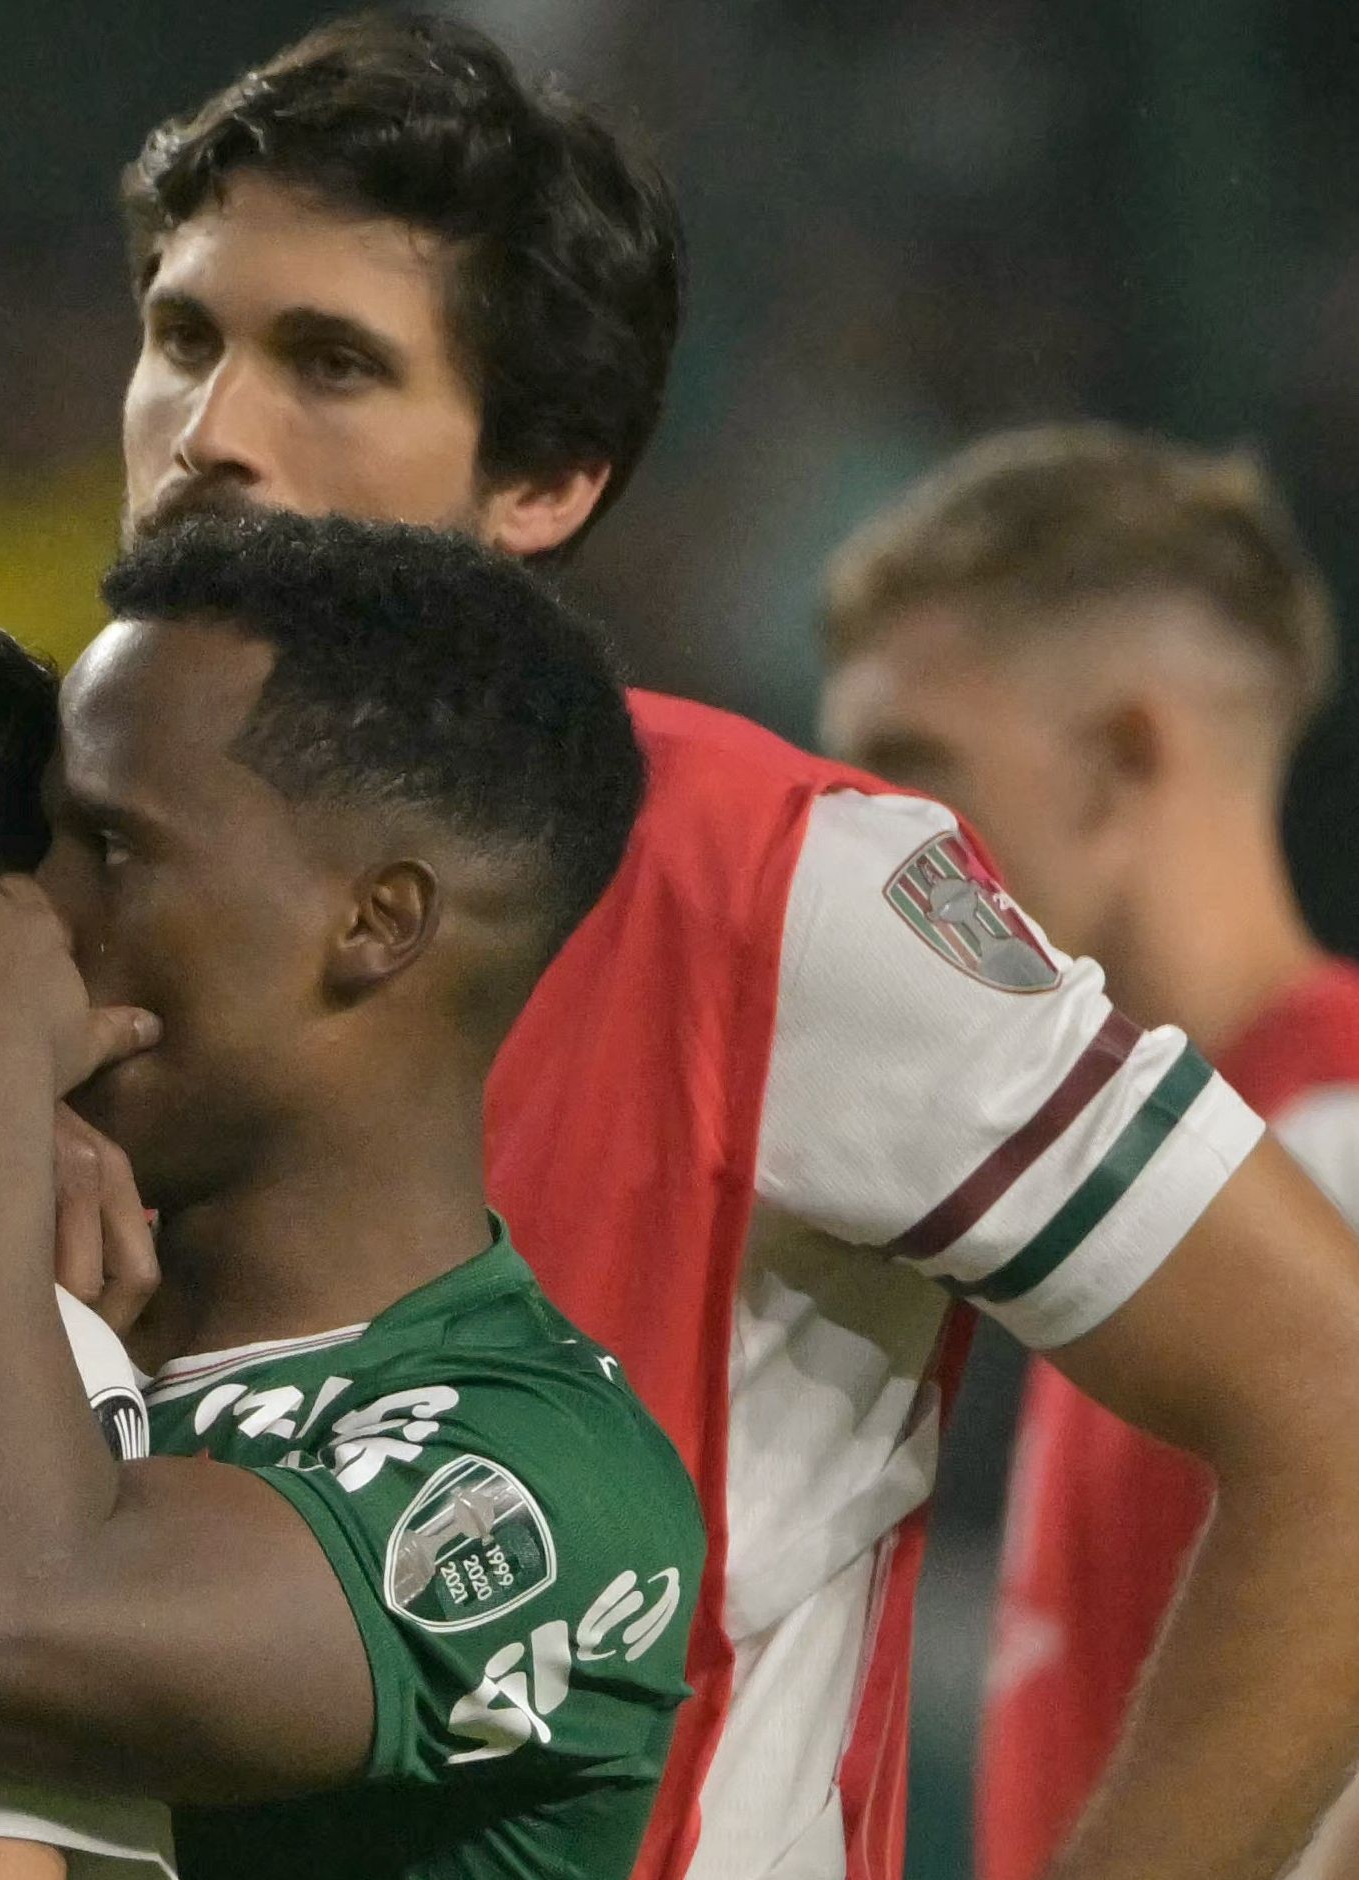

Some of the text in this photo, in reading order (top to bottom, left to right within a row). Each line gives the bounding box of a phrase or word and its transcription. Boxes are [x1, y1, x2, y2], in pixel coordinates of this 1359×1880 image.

[440, 1561, 469, 1605] 2021
[463, 1554, 503, 1601] 2020
[485, 1544, 514, 1587] 1999
